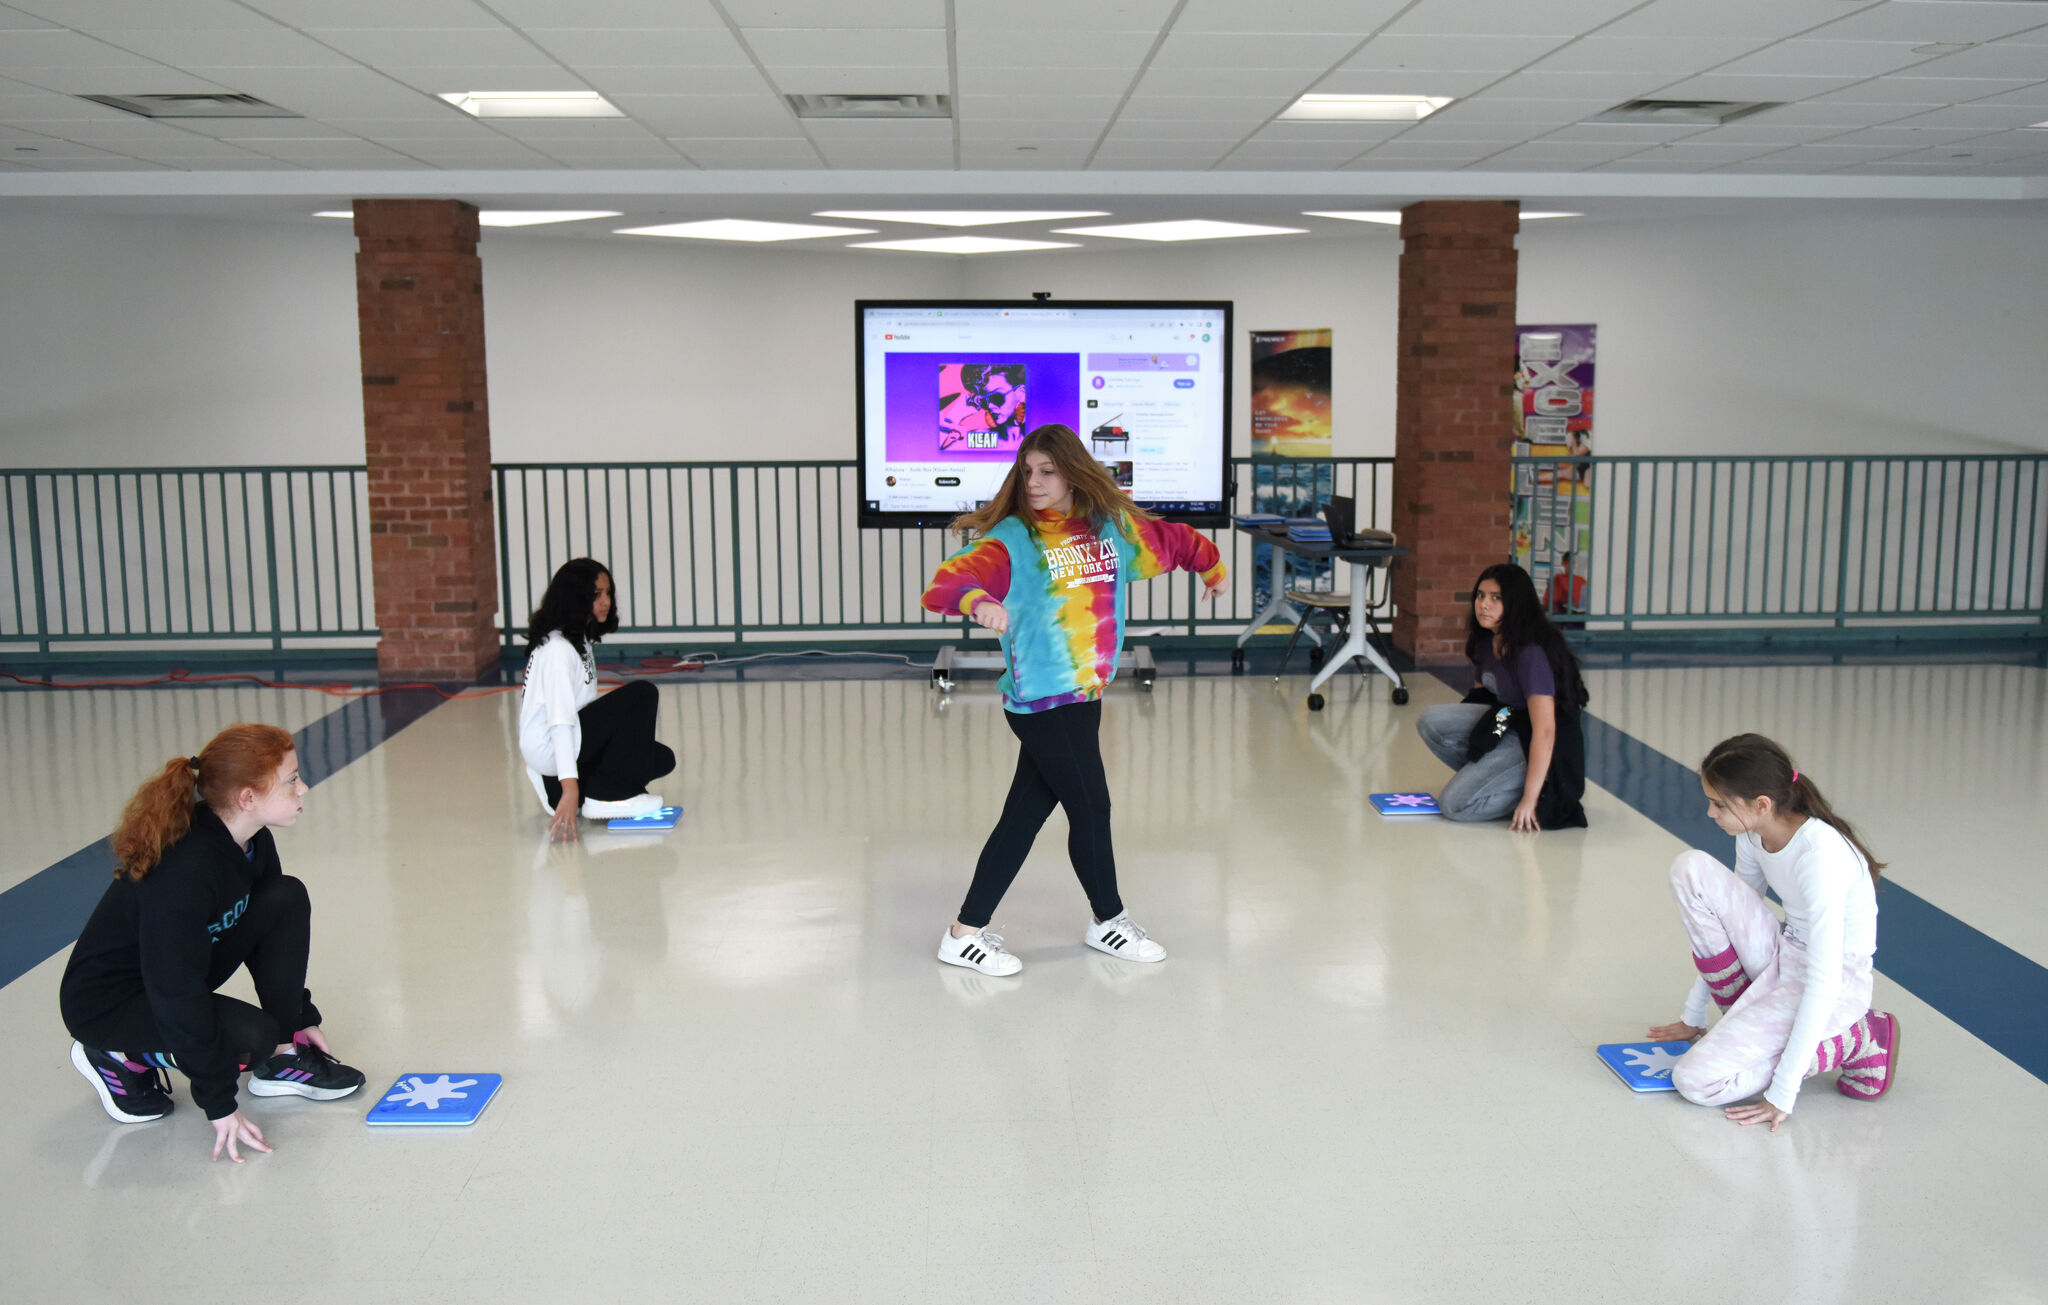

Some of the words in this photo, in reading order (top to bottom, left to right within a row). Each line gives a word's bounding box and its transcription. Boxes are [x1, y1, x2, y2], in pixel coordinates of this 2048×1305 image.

[1043, 543, 1096, 569] BRONX
[1050, 565, 1074, 580] NEW
[1077, 561, 1103, 575] YORK
